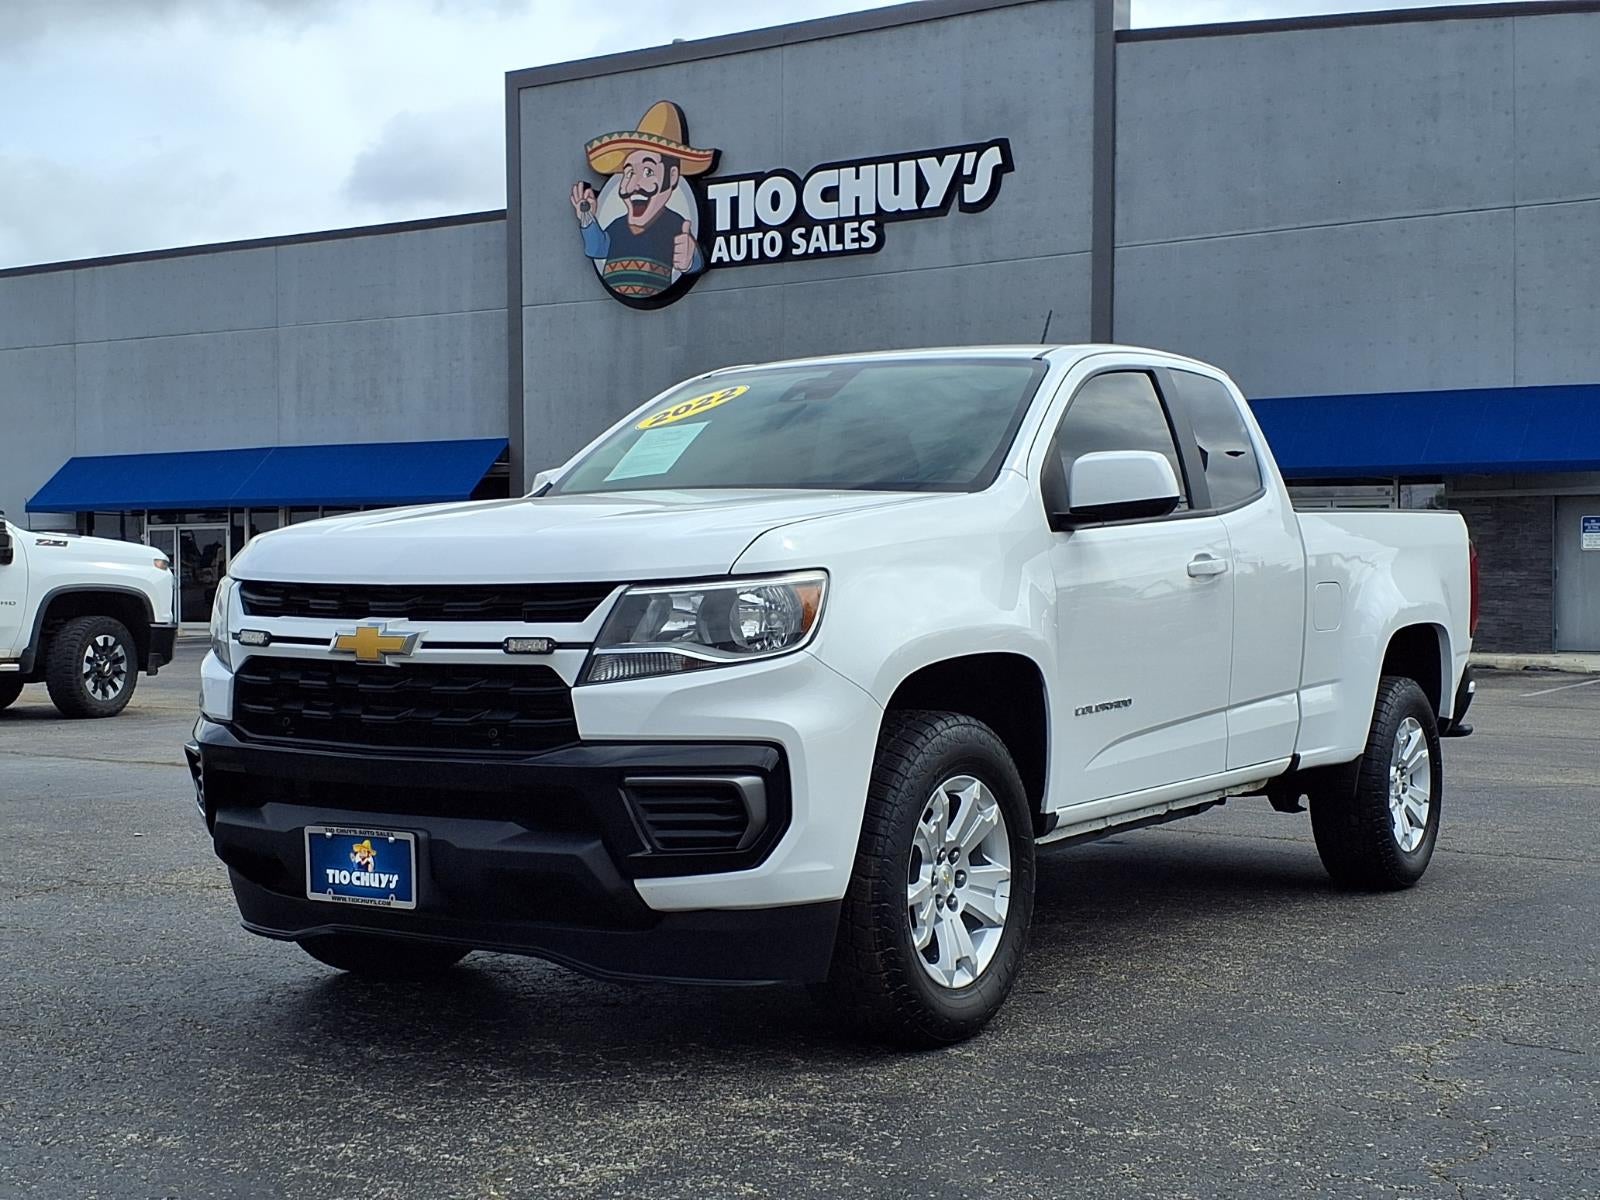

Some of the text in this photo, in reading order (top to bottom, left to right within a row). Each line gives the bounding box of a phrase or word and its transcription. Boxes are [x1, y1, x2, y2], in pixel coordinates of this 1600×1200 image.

[708, 145, 1003, 232] TIO CHUY'S
[710, 220, 877, 263] AUTO SALES
[648, 387, 739, 426] 2022
[326, 869, 398, 888] TIO CHUY'S
